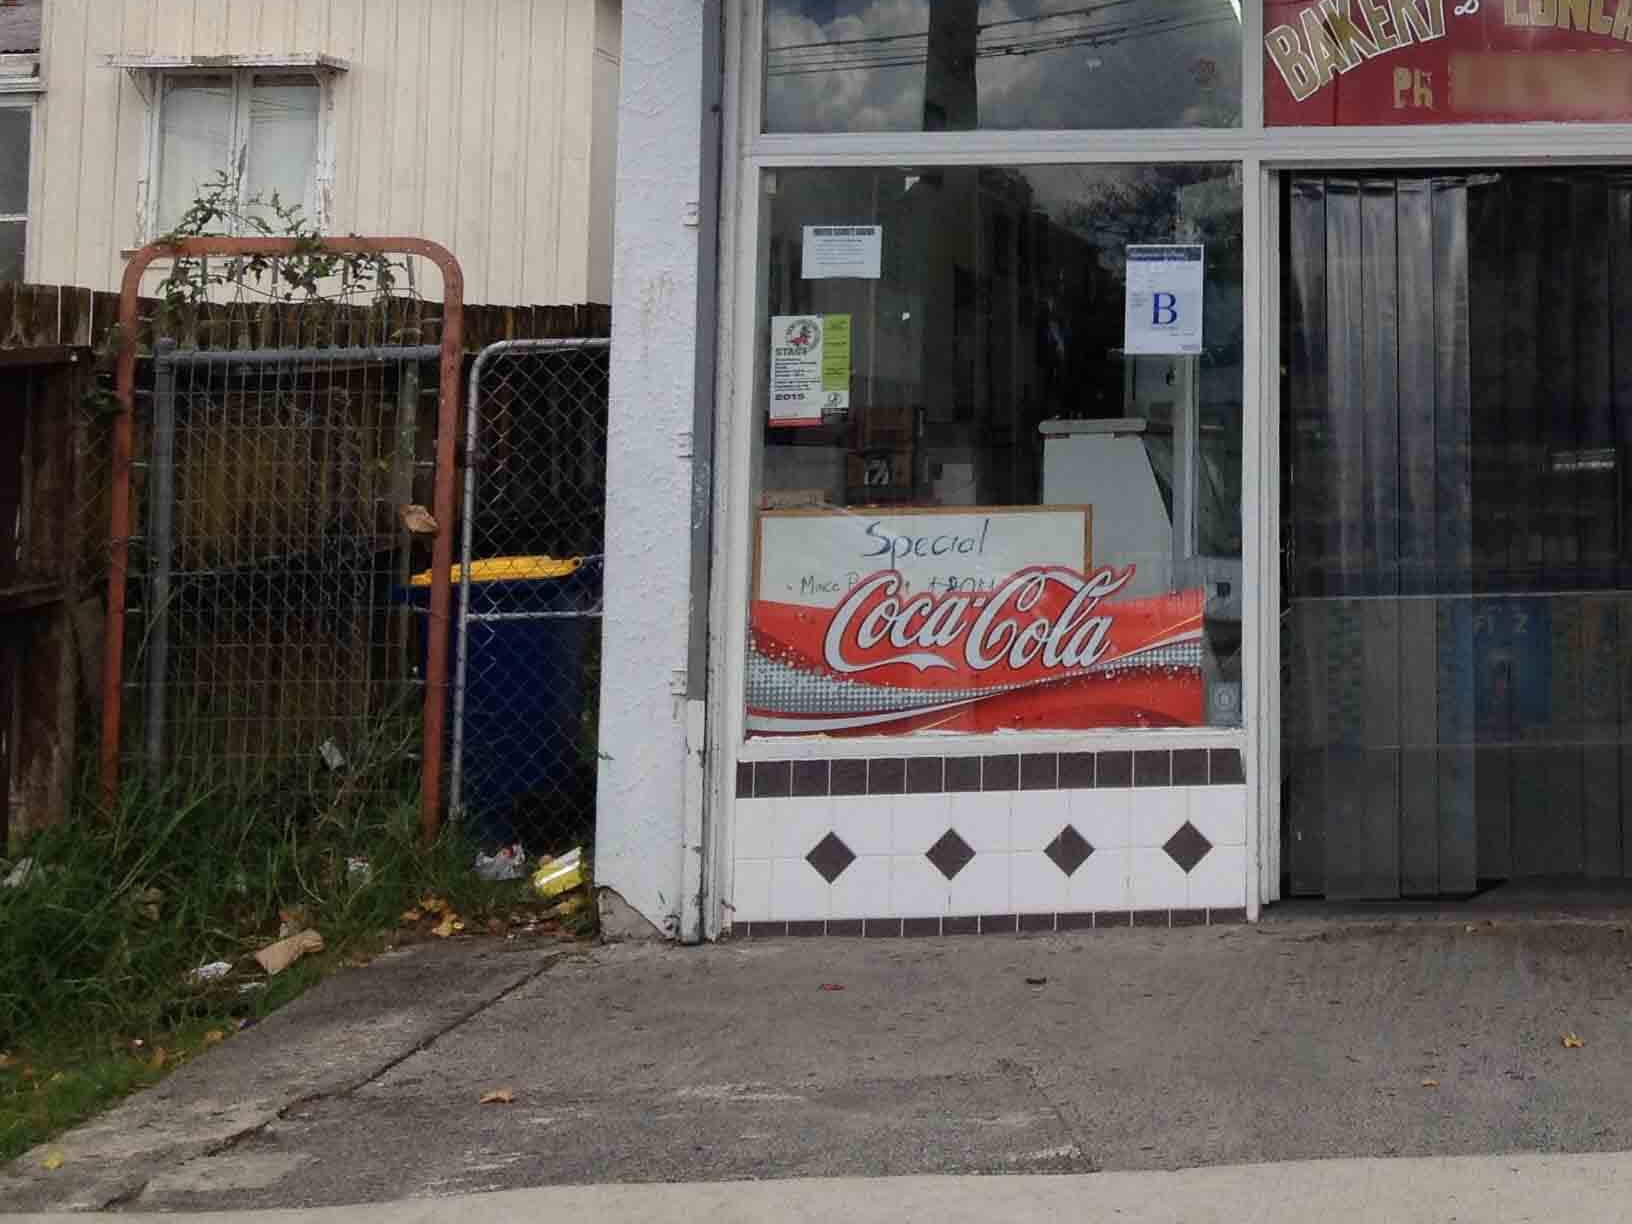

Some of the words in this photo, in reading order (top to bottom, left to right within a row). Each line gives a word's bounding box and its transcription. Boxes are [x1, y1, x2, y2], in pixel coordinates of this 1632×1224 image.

[1152, 292, 1178, 325] B
[861, 517, 991, 571] Special
[823, 565, 1136, 674] Coca-Cola
